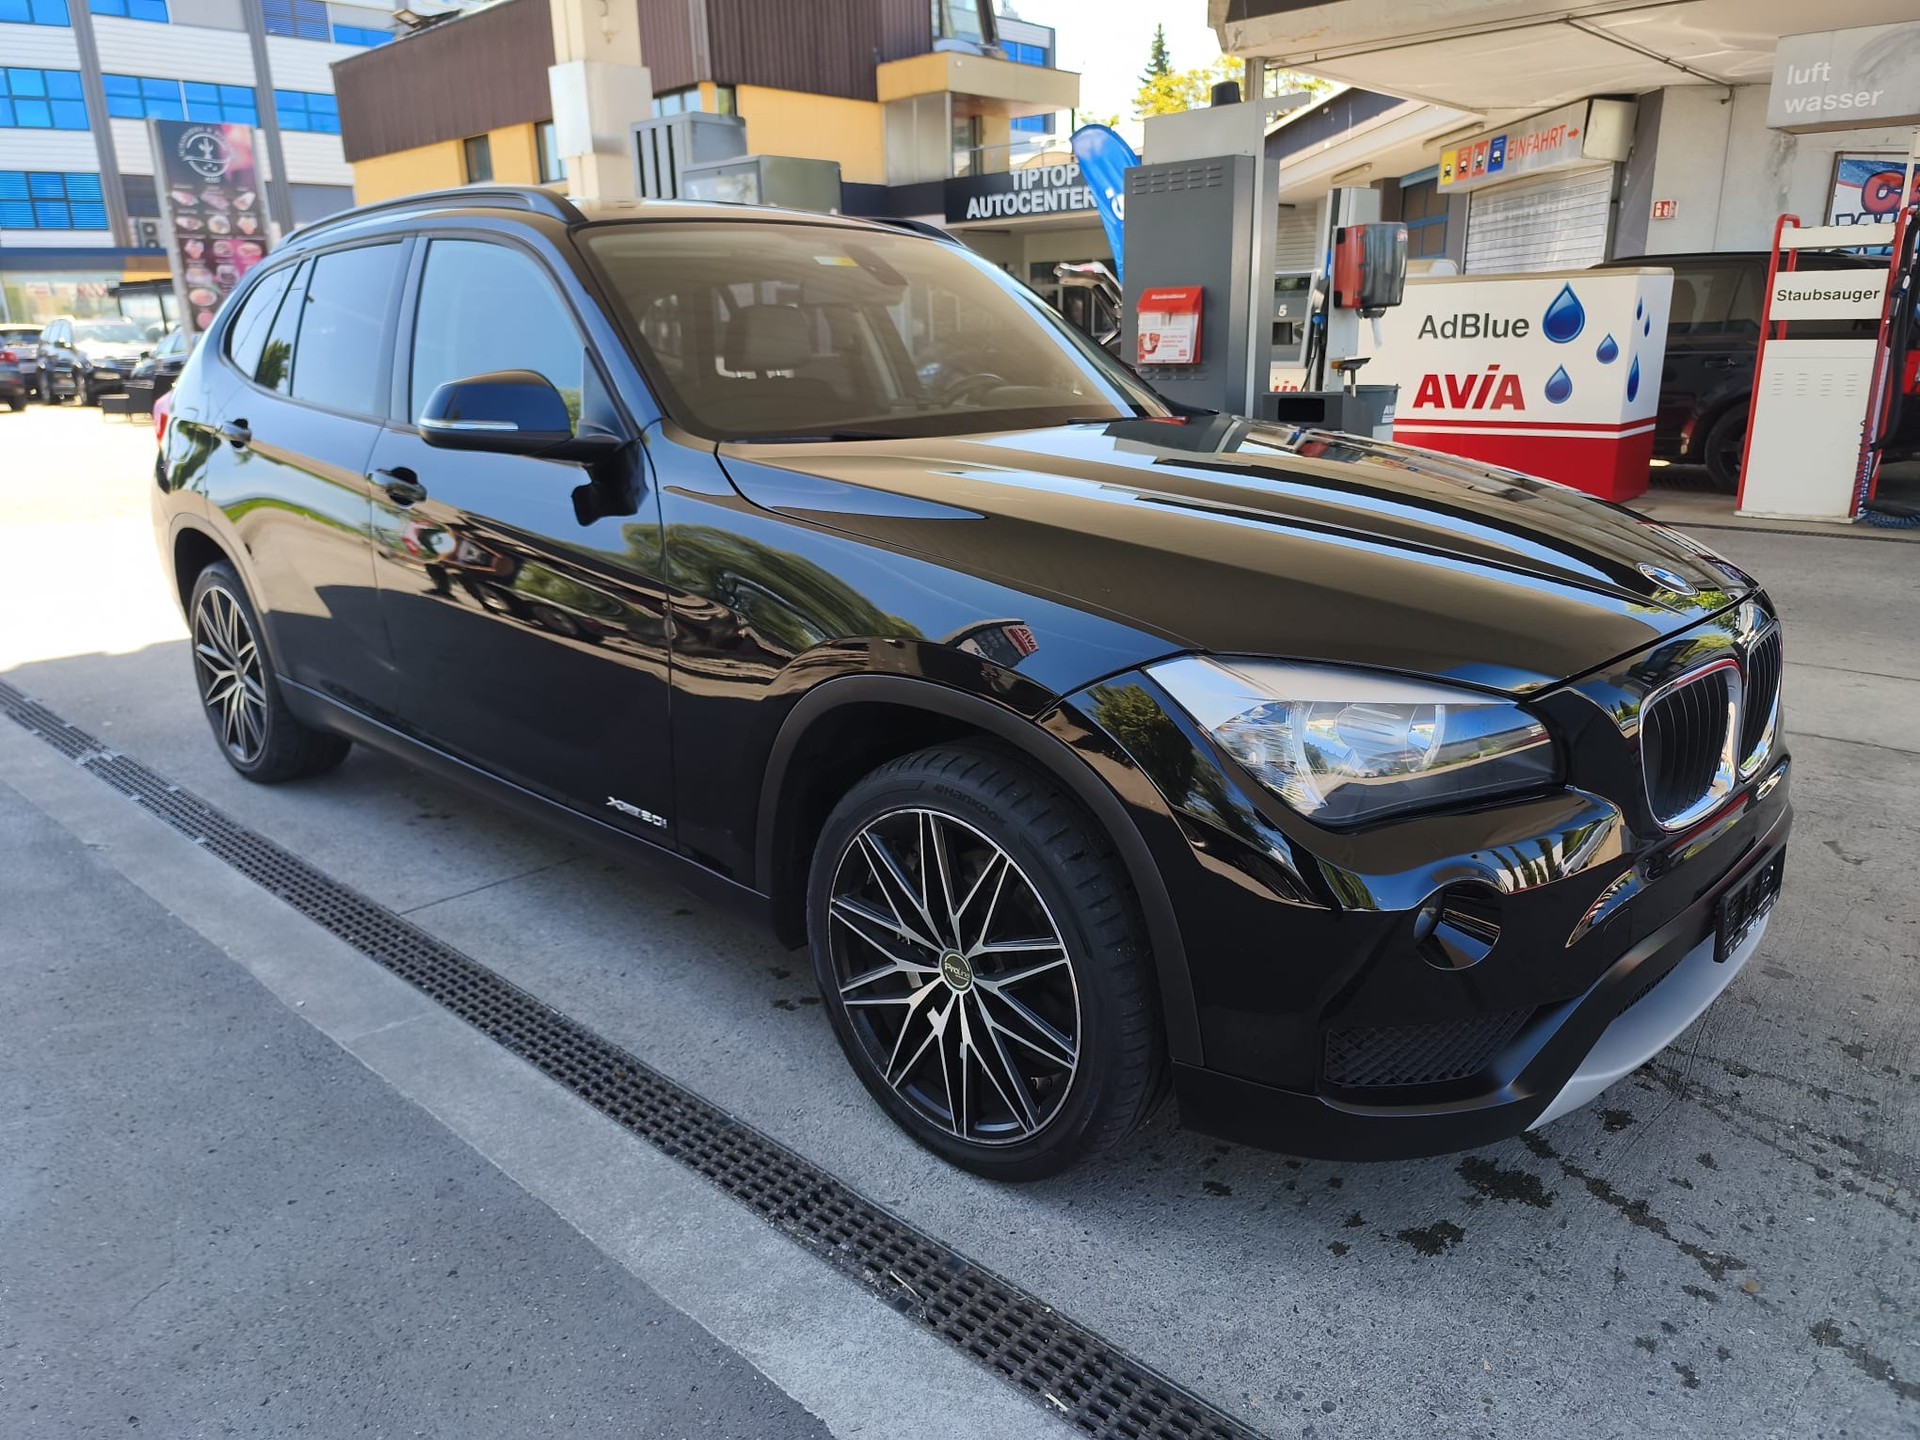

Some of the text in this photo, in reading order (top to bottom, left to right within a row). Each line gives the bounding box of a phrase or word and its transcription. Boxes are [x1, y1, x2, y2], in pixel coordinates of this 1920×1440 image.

[1786, 62, 1832, 85] luft
[1785, 89, 1884, 113] wasser
[1507, 124, 1567, 161] EINFAHRT
[1010, 164, 1080, 191] TIPTOP
[966, 185, 1098, 219] AUTOCENTER
[1776, 289, 1880, 303] Staubsauger
[1417, 313, 1530, 340] AdBlue
